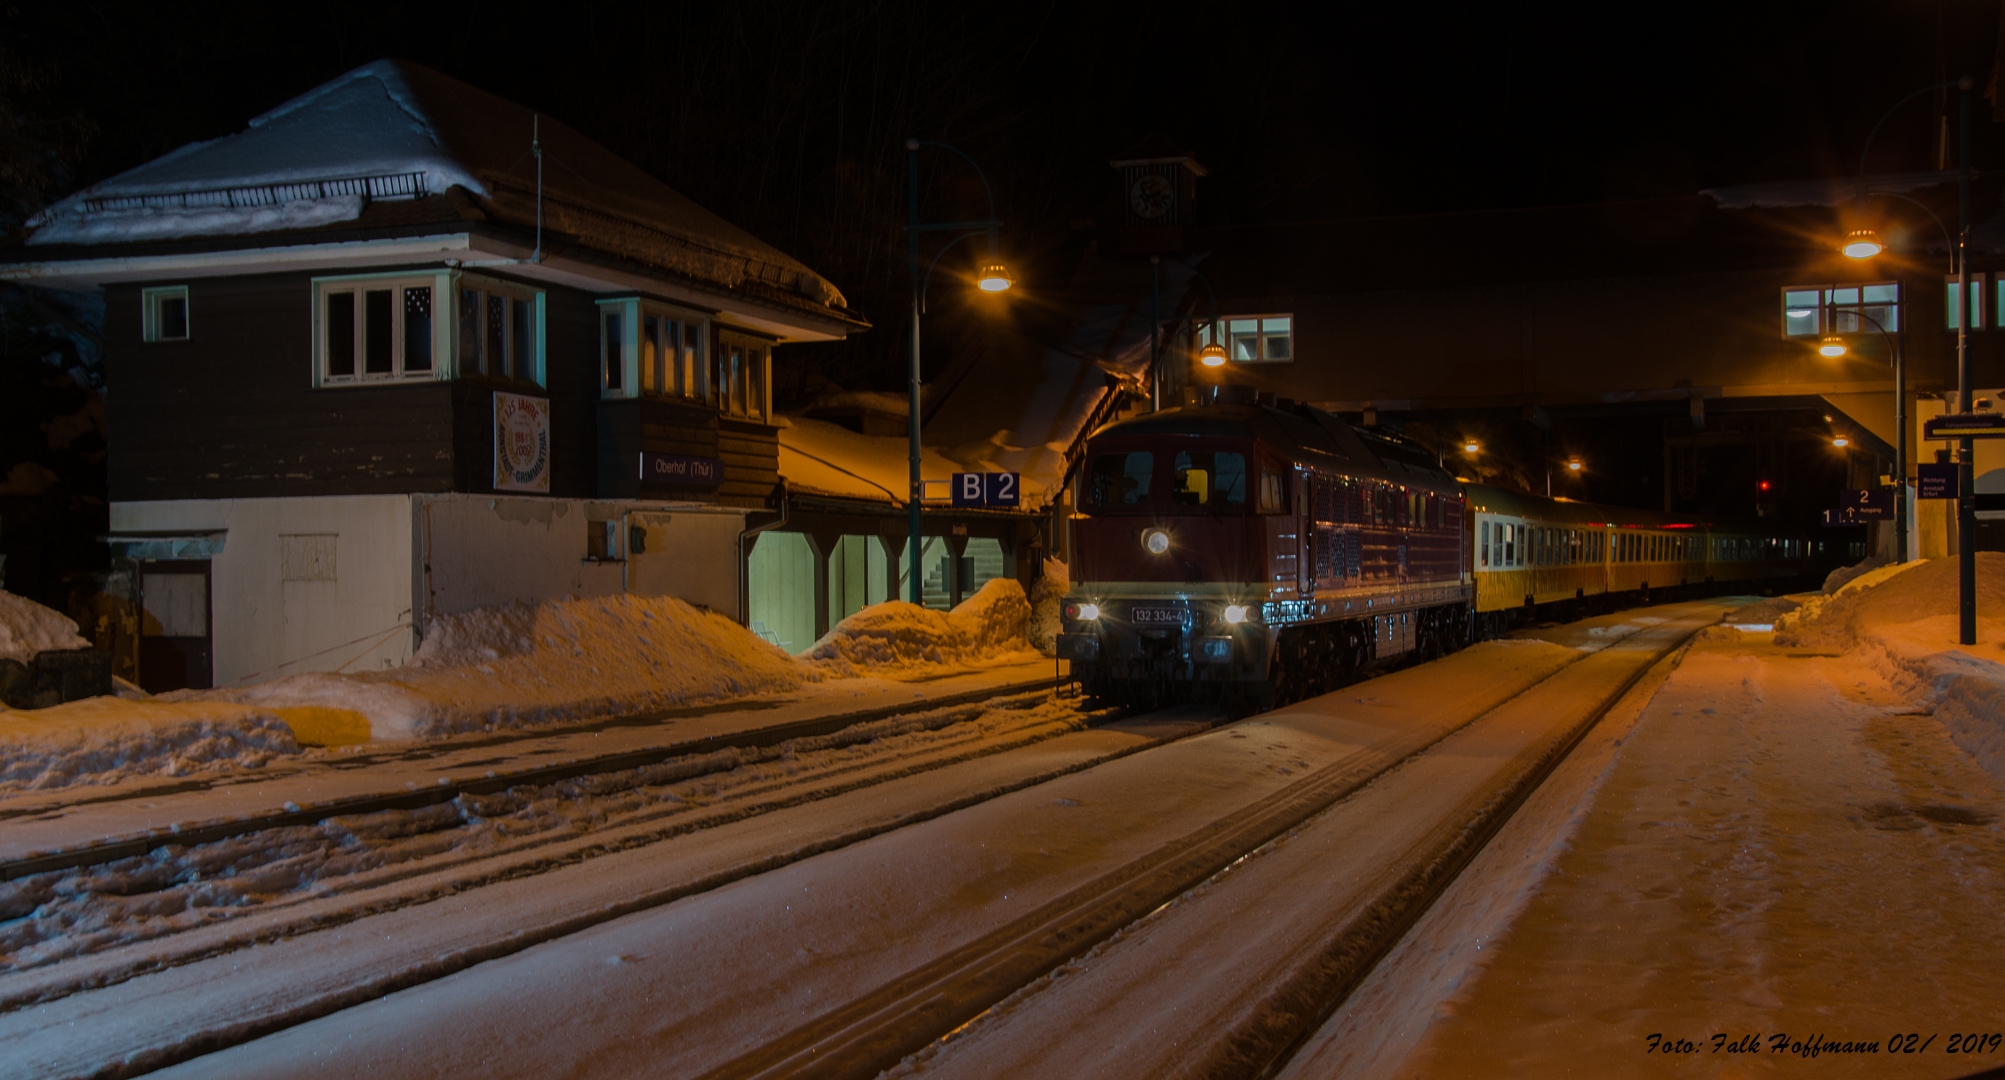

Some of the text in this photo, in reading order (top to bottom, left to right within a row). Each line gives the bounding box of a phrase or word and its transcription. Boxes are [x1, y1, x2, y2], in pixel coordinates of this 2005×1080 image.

[504, 399, 539, 421] 125 JAHRE
[655, 459, 714, 480] Oberhof (Thür)
[963, 473, 1014, 500] B 2
[1860, 490, 1869, 503] 2
[1823, 509, 1830, 523] 1
[1136, 610, 1183, 621] 132 334-4
